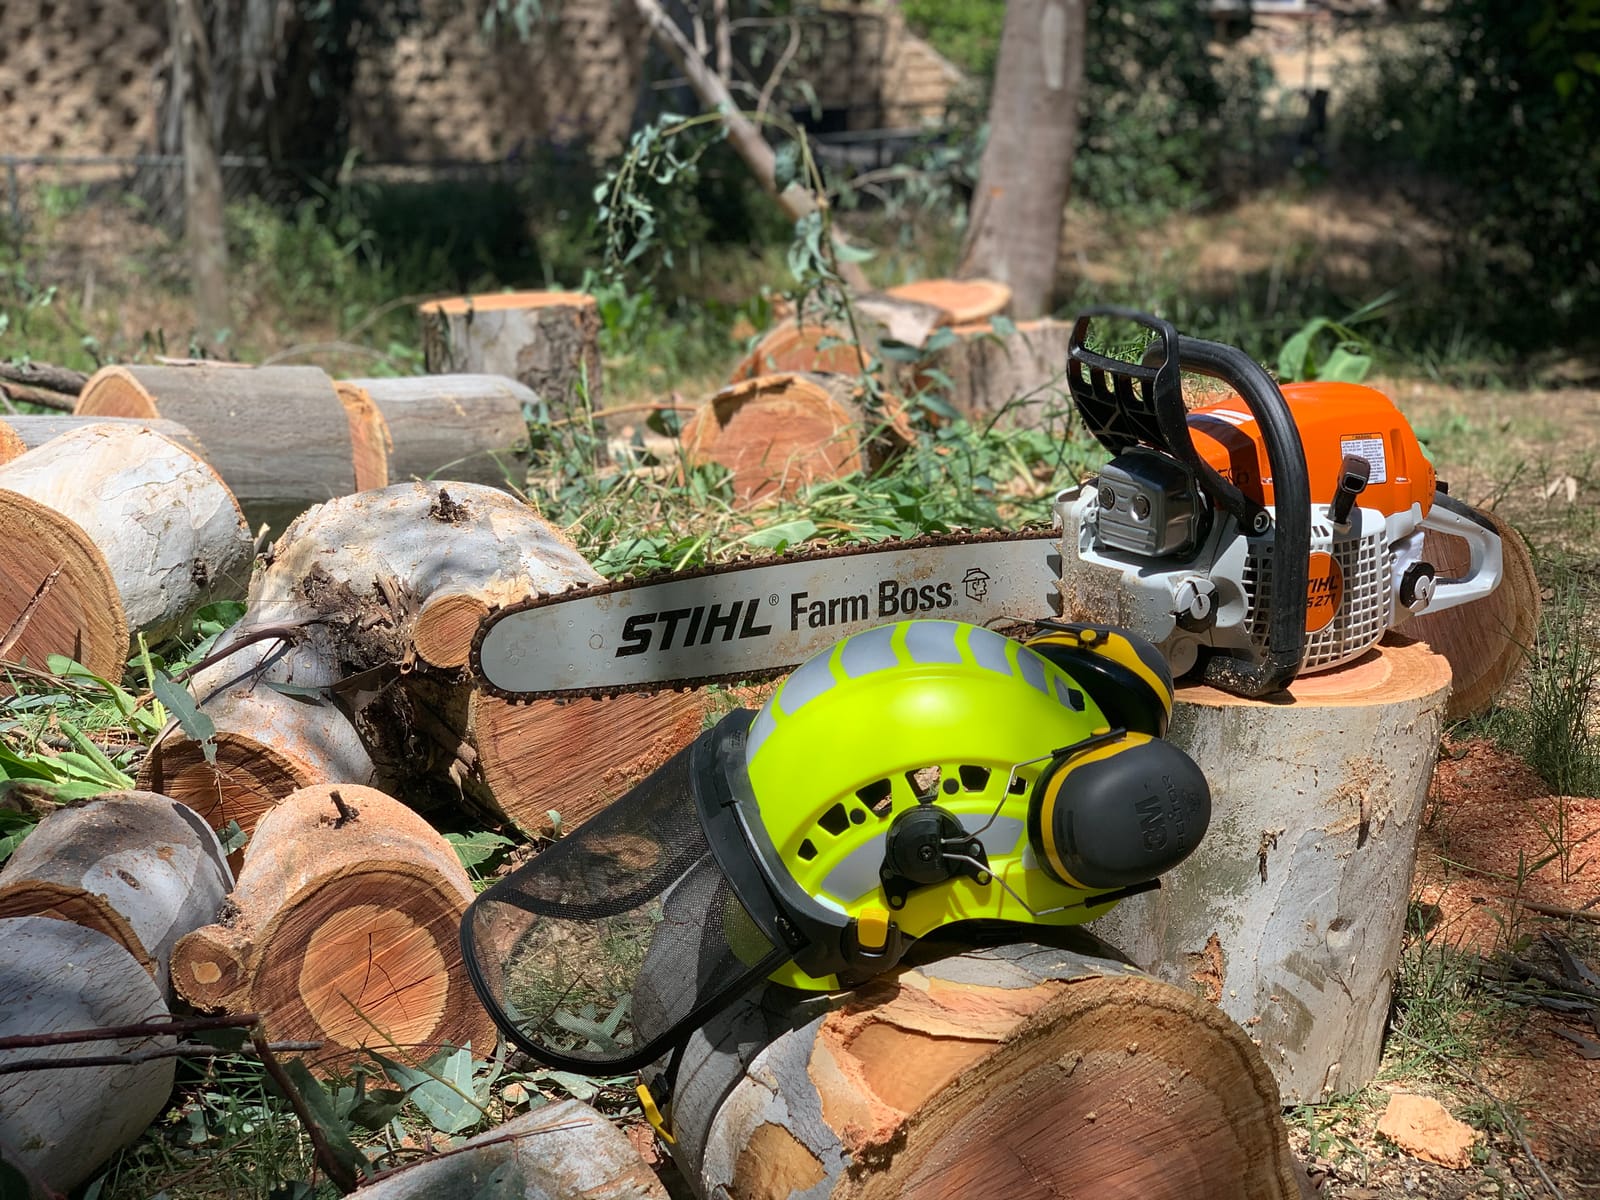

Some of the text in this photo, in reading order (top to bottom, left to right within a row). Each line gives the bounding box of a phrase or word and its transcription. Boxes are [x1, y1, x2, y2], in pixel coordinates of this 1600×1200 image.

[615, 579, 953, 657] STIHL Farm Boss
[1135, 794, 1169, 853] 3M
